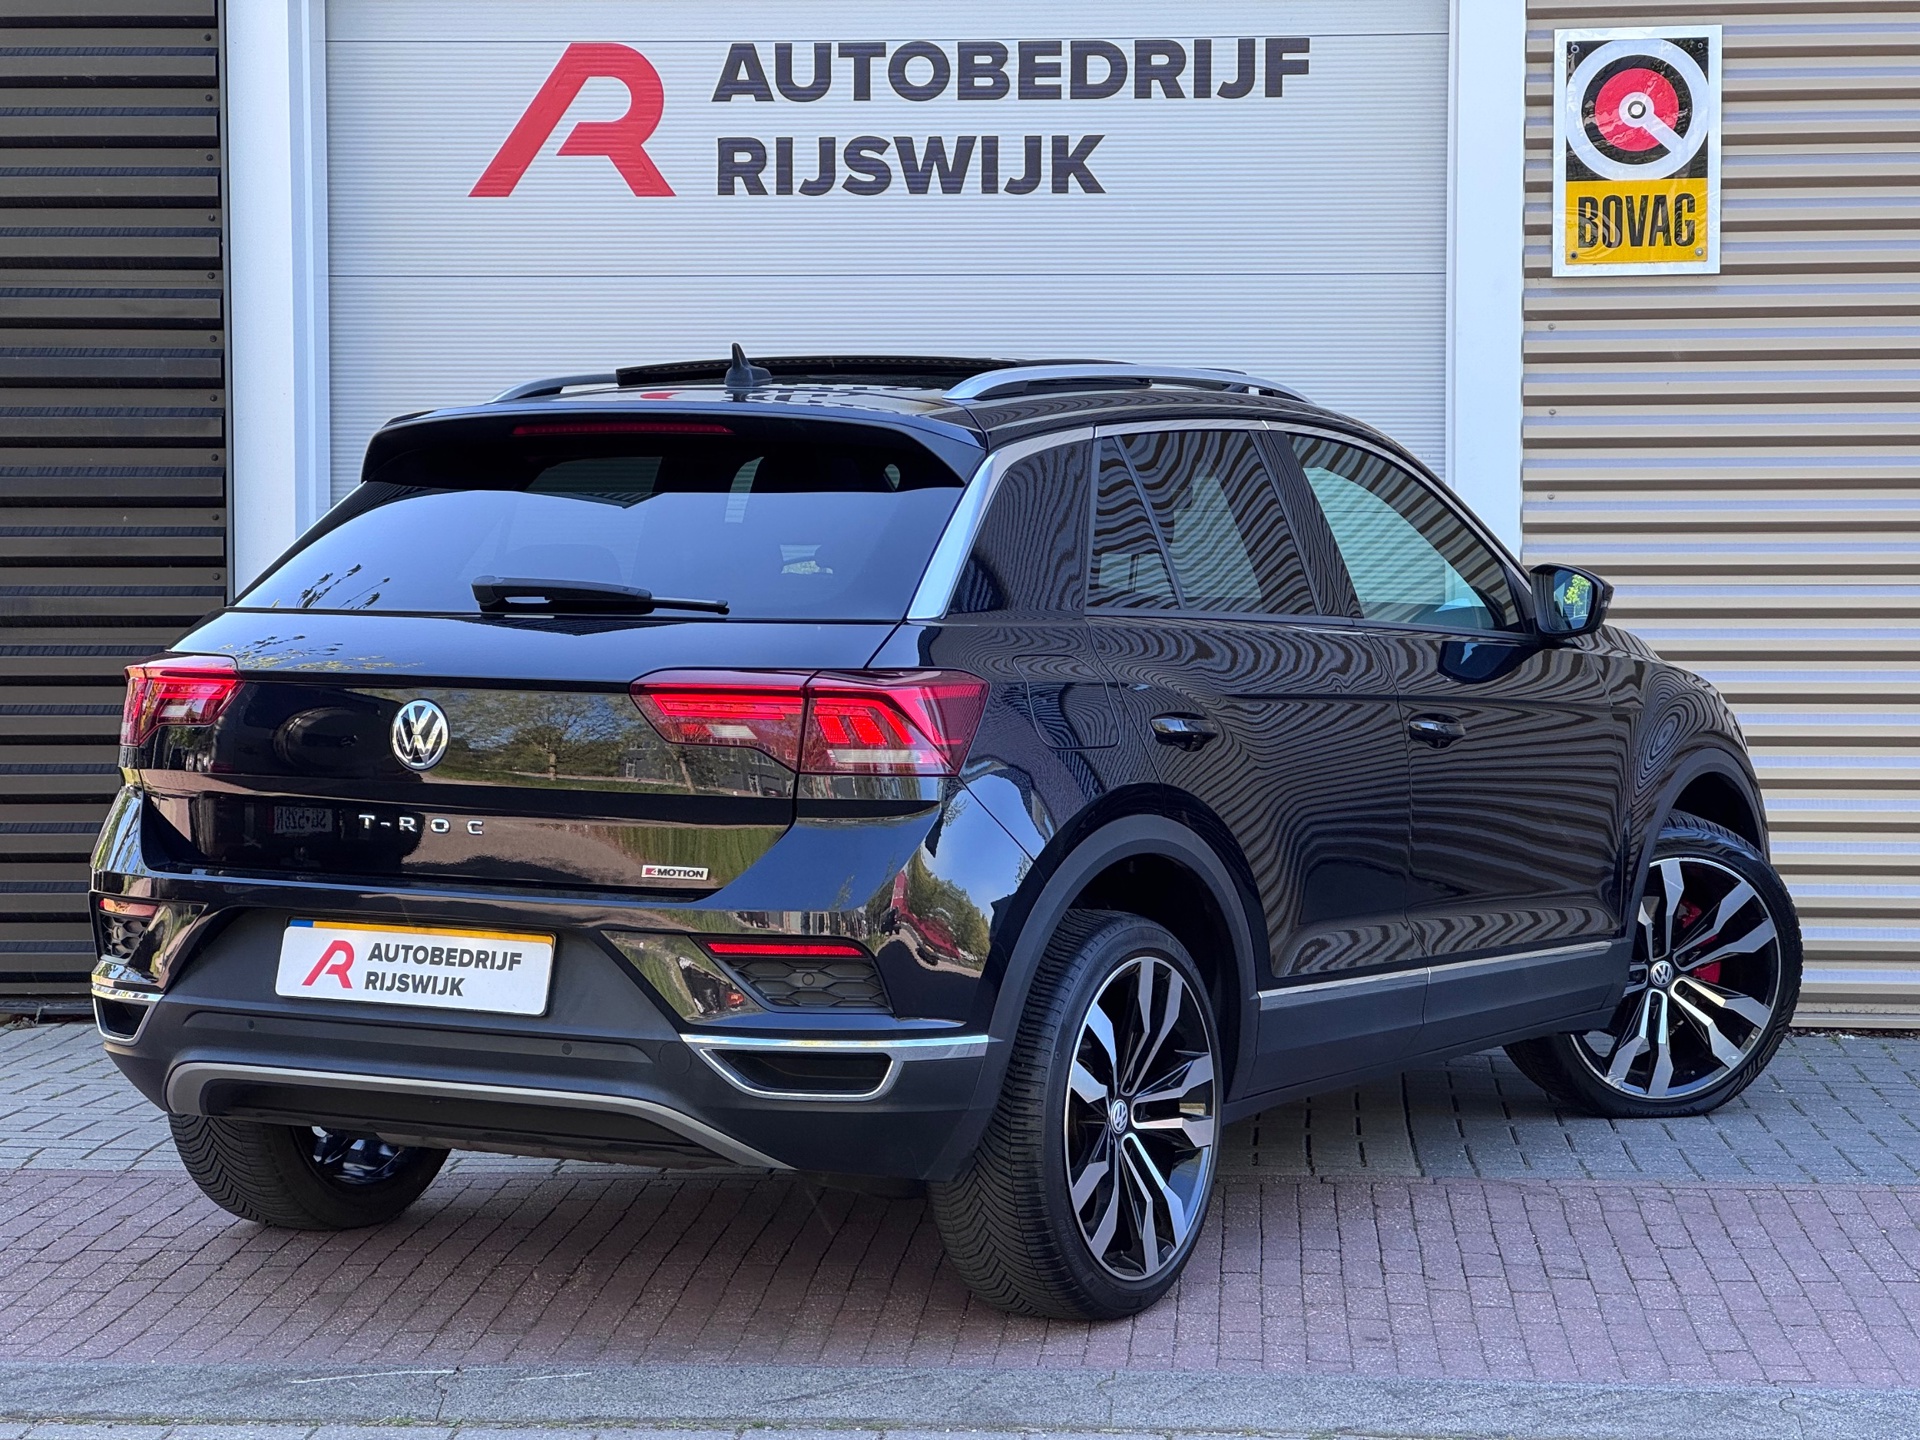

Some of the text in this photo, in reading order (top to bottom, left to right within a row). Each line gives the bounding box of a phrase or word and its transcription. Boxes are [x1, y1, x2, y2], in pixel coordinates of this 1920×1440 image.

[711, 37, 1311, 103] AUTOBEDRIJF
[716, 134, 1107, 196] RIJSWIJK
[1577, 193, 1696, 248] BOVAG
[358, 813, 485, 836] T-ROC
[645, 867, 705, 879] 4MOTION
[367, 942, 523, 972] AUTOBEDRIJF
[364, 970, 466, 998] RIJSWIJK
